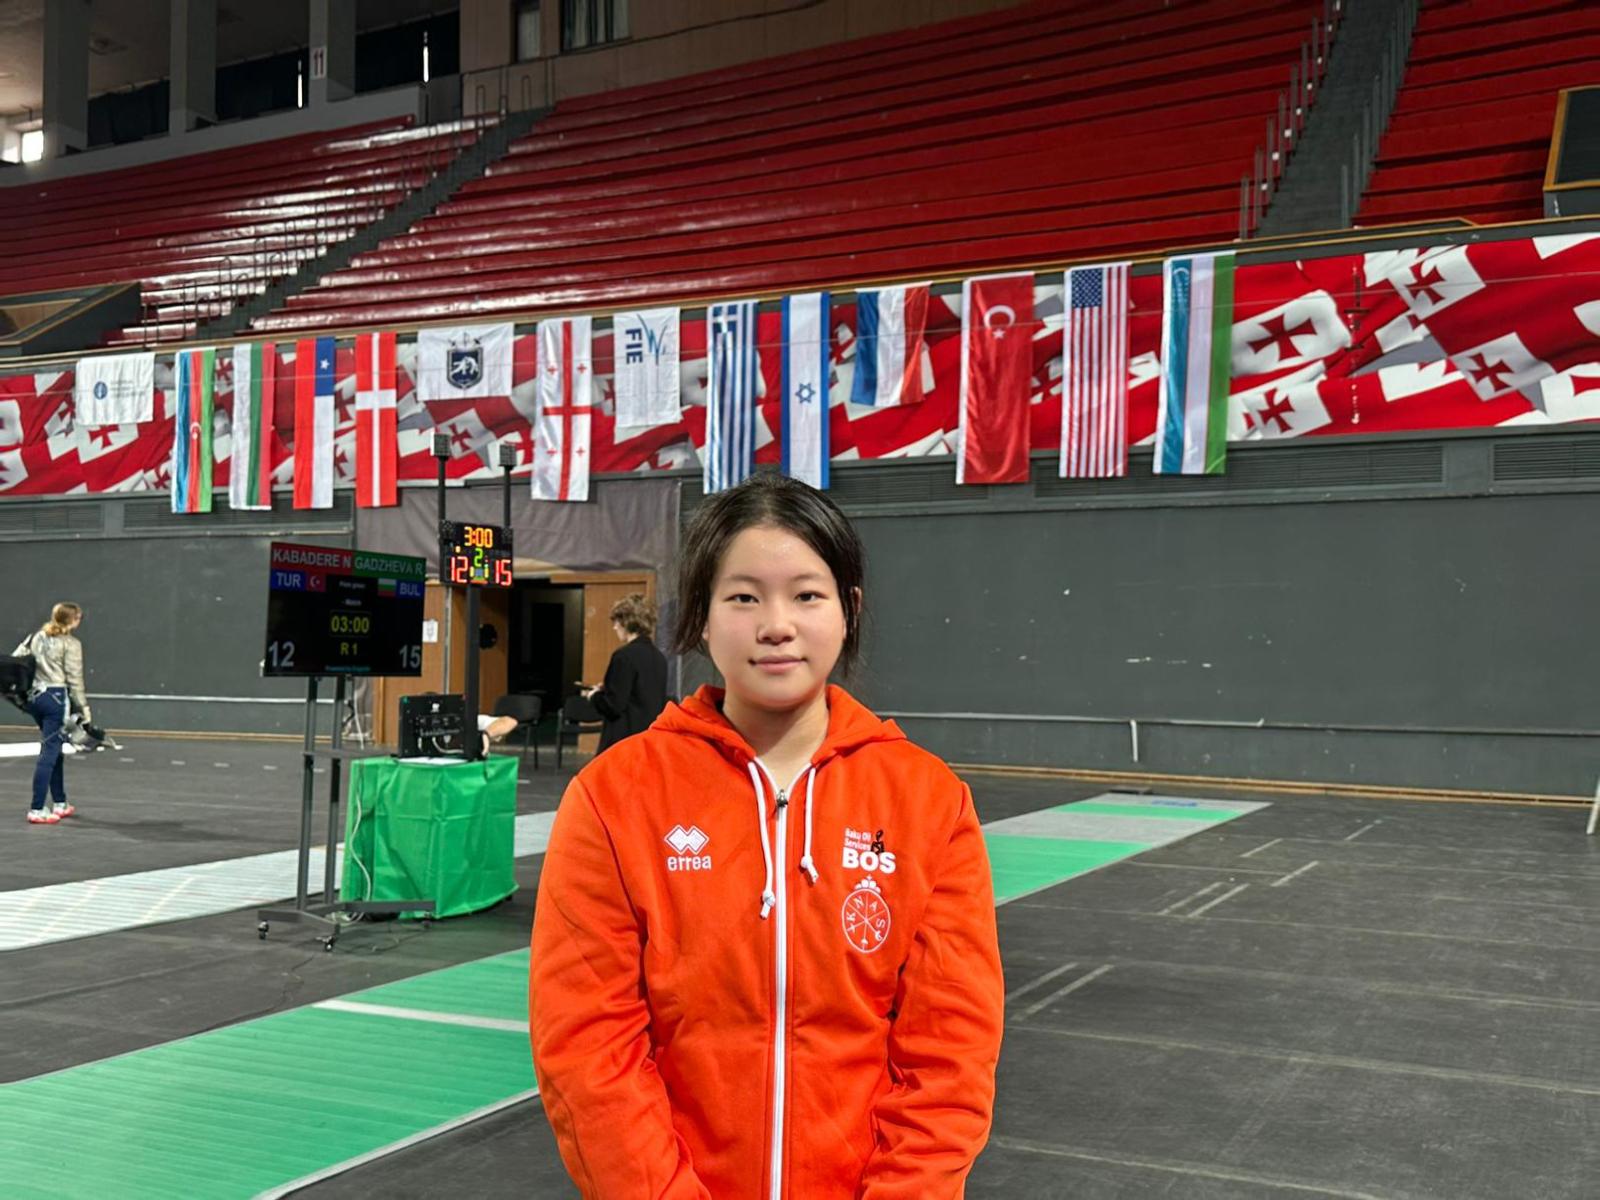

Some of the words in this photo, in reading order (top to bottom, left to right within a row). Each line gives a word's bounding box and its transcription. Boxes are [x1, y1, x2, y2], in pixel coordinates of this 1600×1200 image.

[625, 328, 643, 365] FIE
[464, 526, 493, 548] 3:00
[273, 548, 340, 568] KABADERE
[342, 556, 351, 568] N
[354, 556, 413, 574] GADZHEVA
[415, 562, 423, 575] R
[474, 547, 484, 567] 2
[276, 572, 301, 587] TUR
[450, 556, 469, 583] 12
[495, 560, 512, 586] 15
[399, 582, 421, 596] BUL
[331, 615, 370, 633] 03:00
[268, 641, 296, 667] 12
[399, 645, 421, 668] 15
[667, 855, 712, 871] errea
[842, 847, 896, 874] BOS
